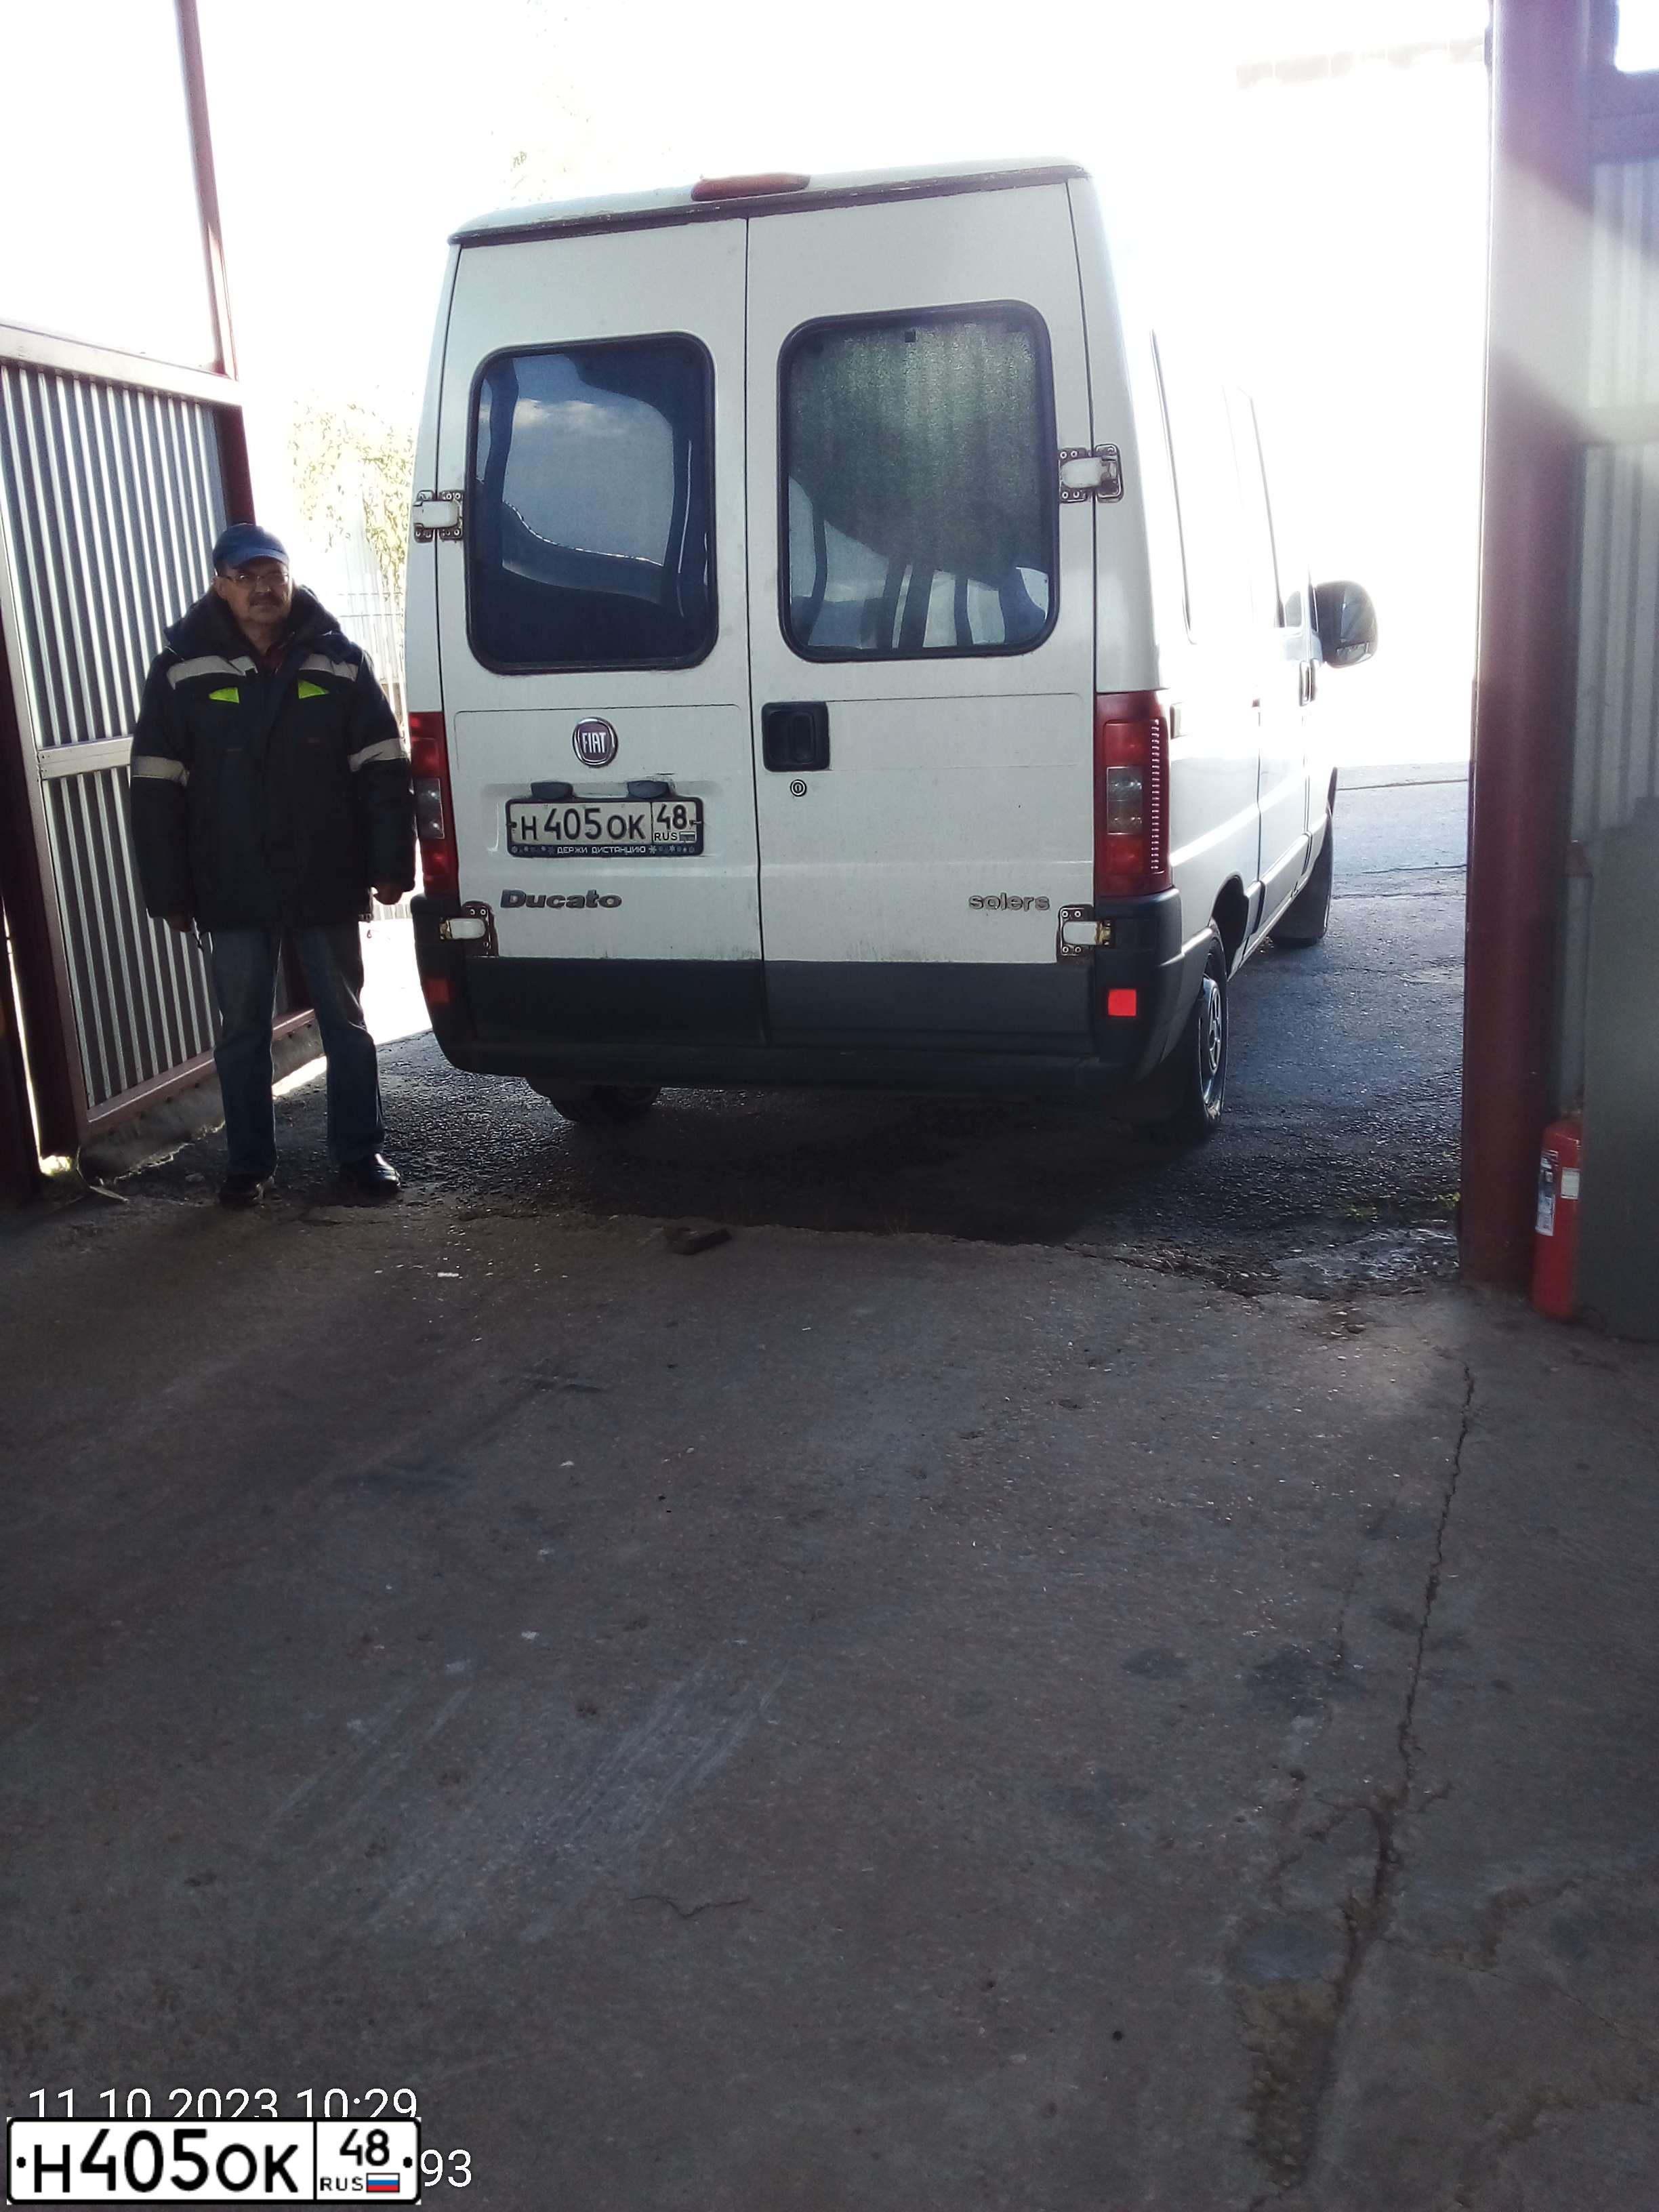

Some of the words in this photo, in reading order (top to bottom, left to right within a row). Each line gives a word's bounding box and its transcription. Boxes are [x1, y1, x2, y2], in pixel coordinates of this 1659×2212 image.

[581, 732, 607, 754] FIAT
[656, 804, 689, 830] 48
[653, 832, 678, 842] RUS
[500, 889, 622, 909] Ducato
[968, 892, 1050, 912] solers
